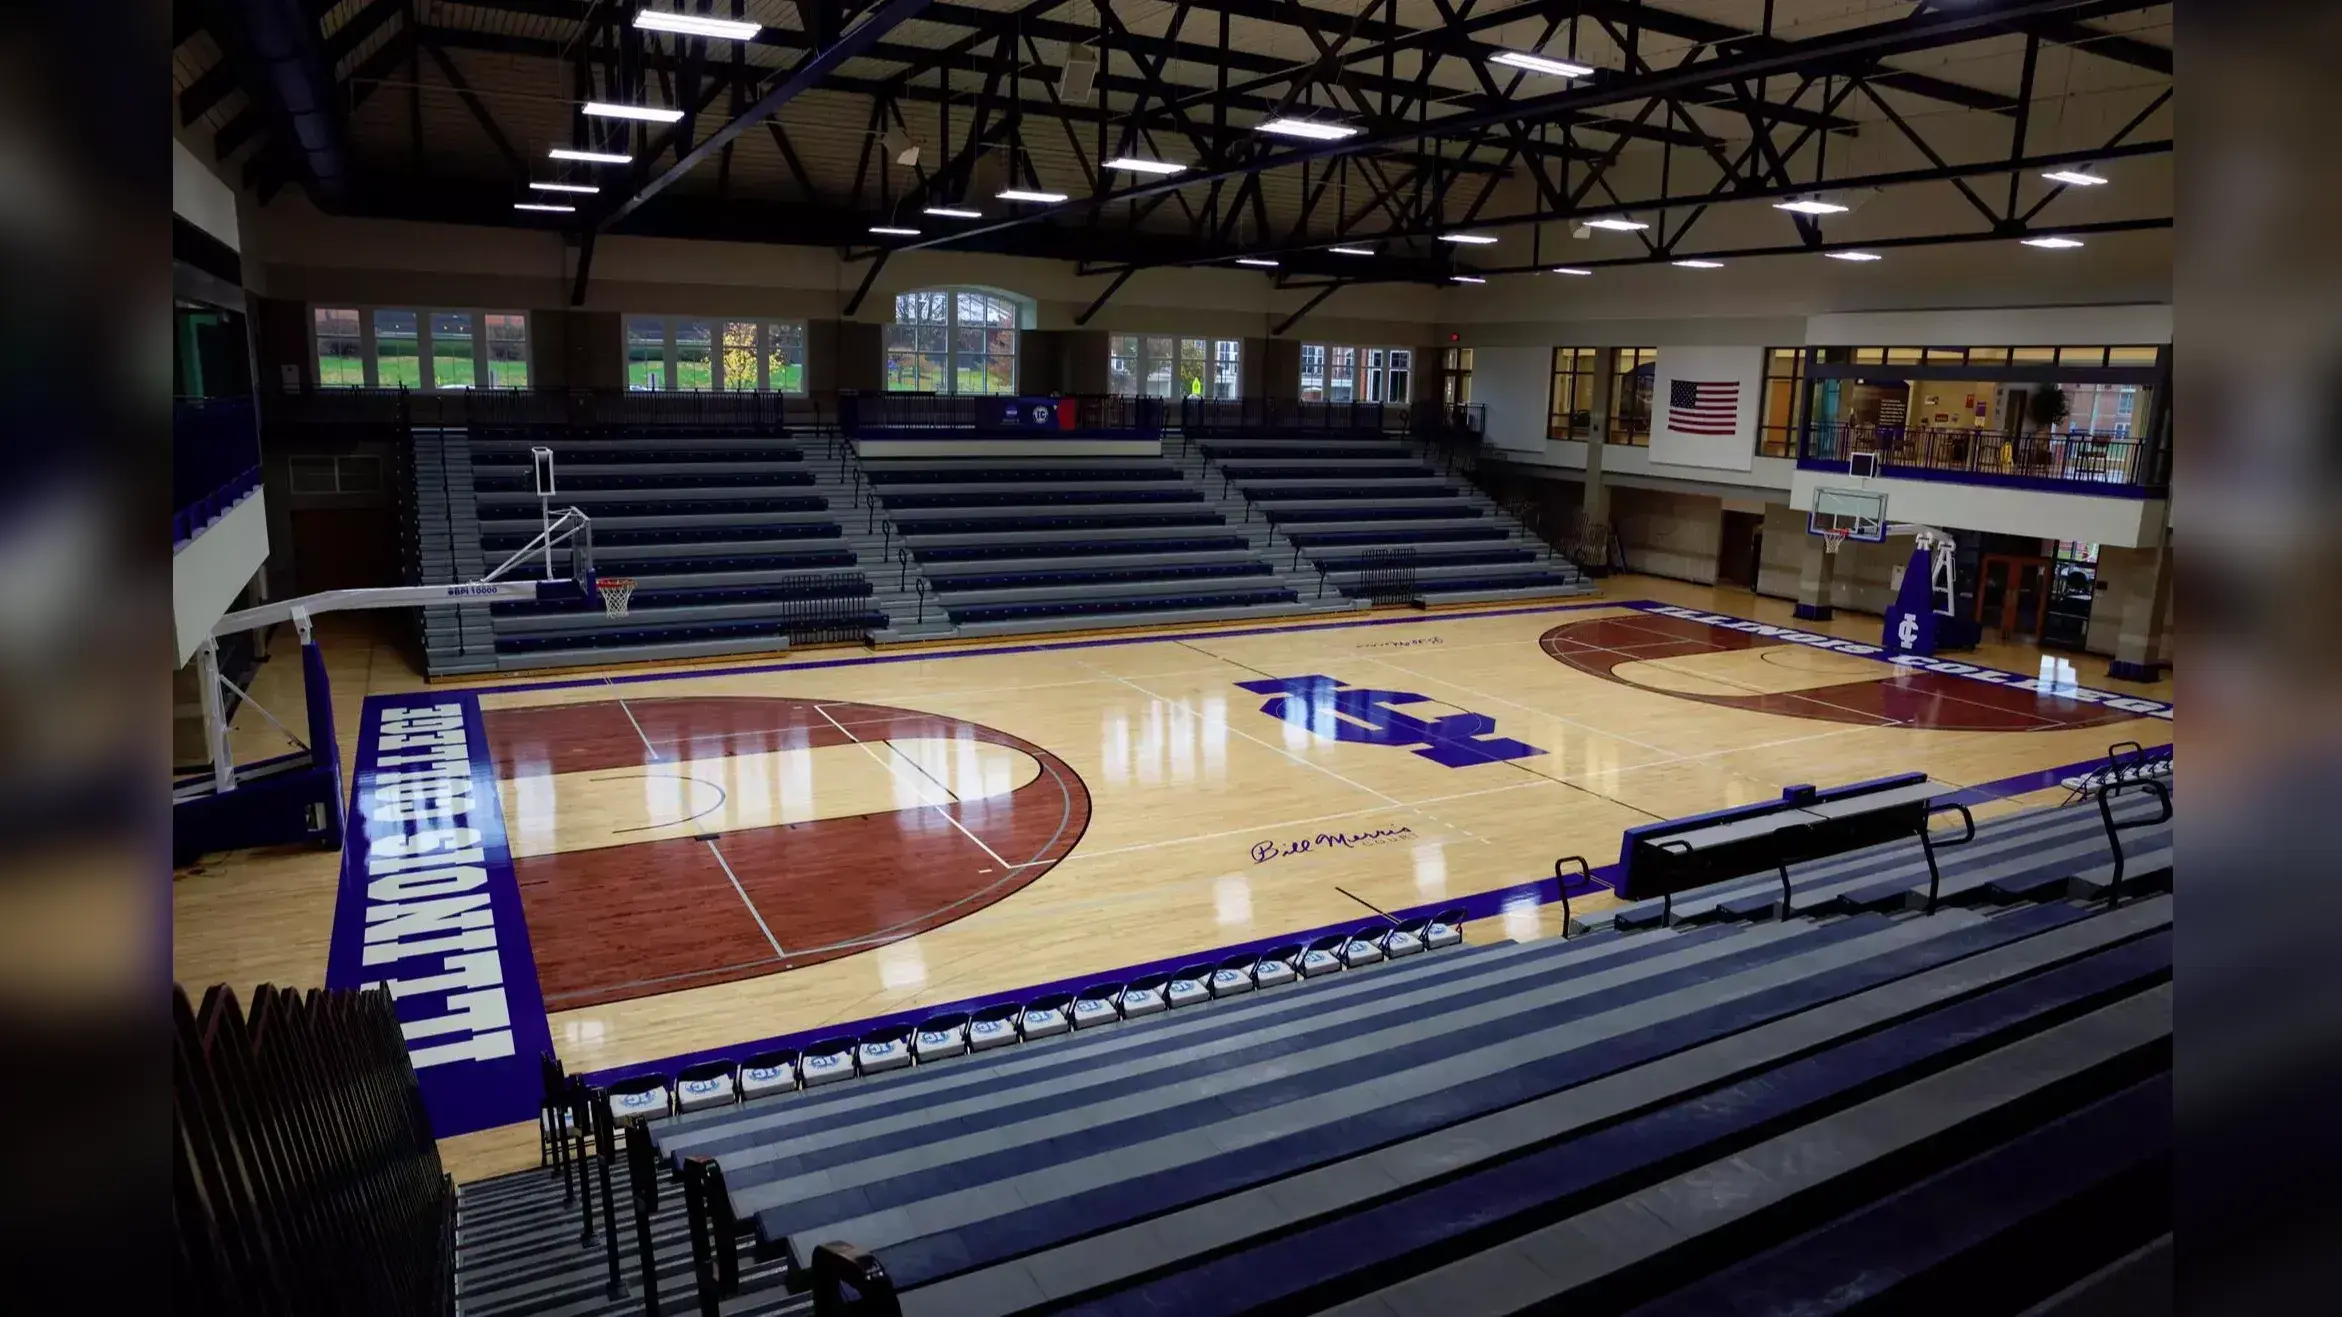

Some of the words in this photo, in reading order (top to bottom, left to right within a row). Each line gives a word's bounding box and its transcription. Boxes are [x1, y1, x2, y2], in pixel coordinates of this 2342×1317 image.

[471, 586, 498, 595] 10000
[1642, 606, 1884, 654] ILLINOIS
[373, 702, 476, 822] COLLEGE
[1251, 840, 1311, 865] Bill
[360, 827, 516, 1070] ILLINOIS
